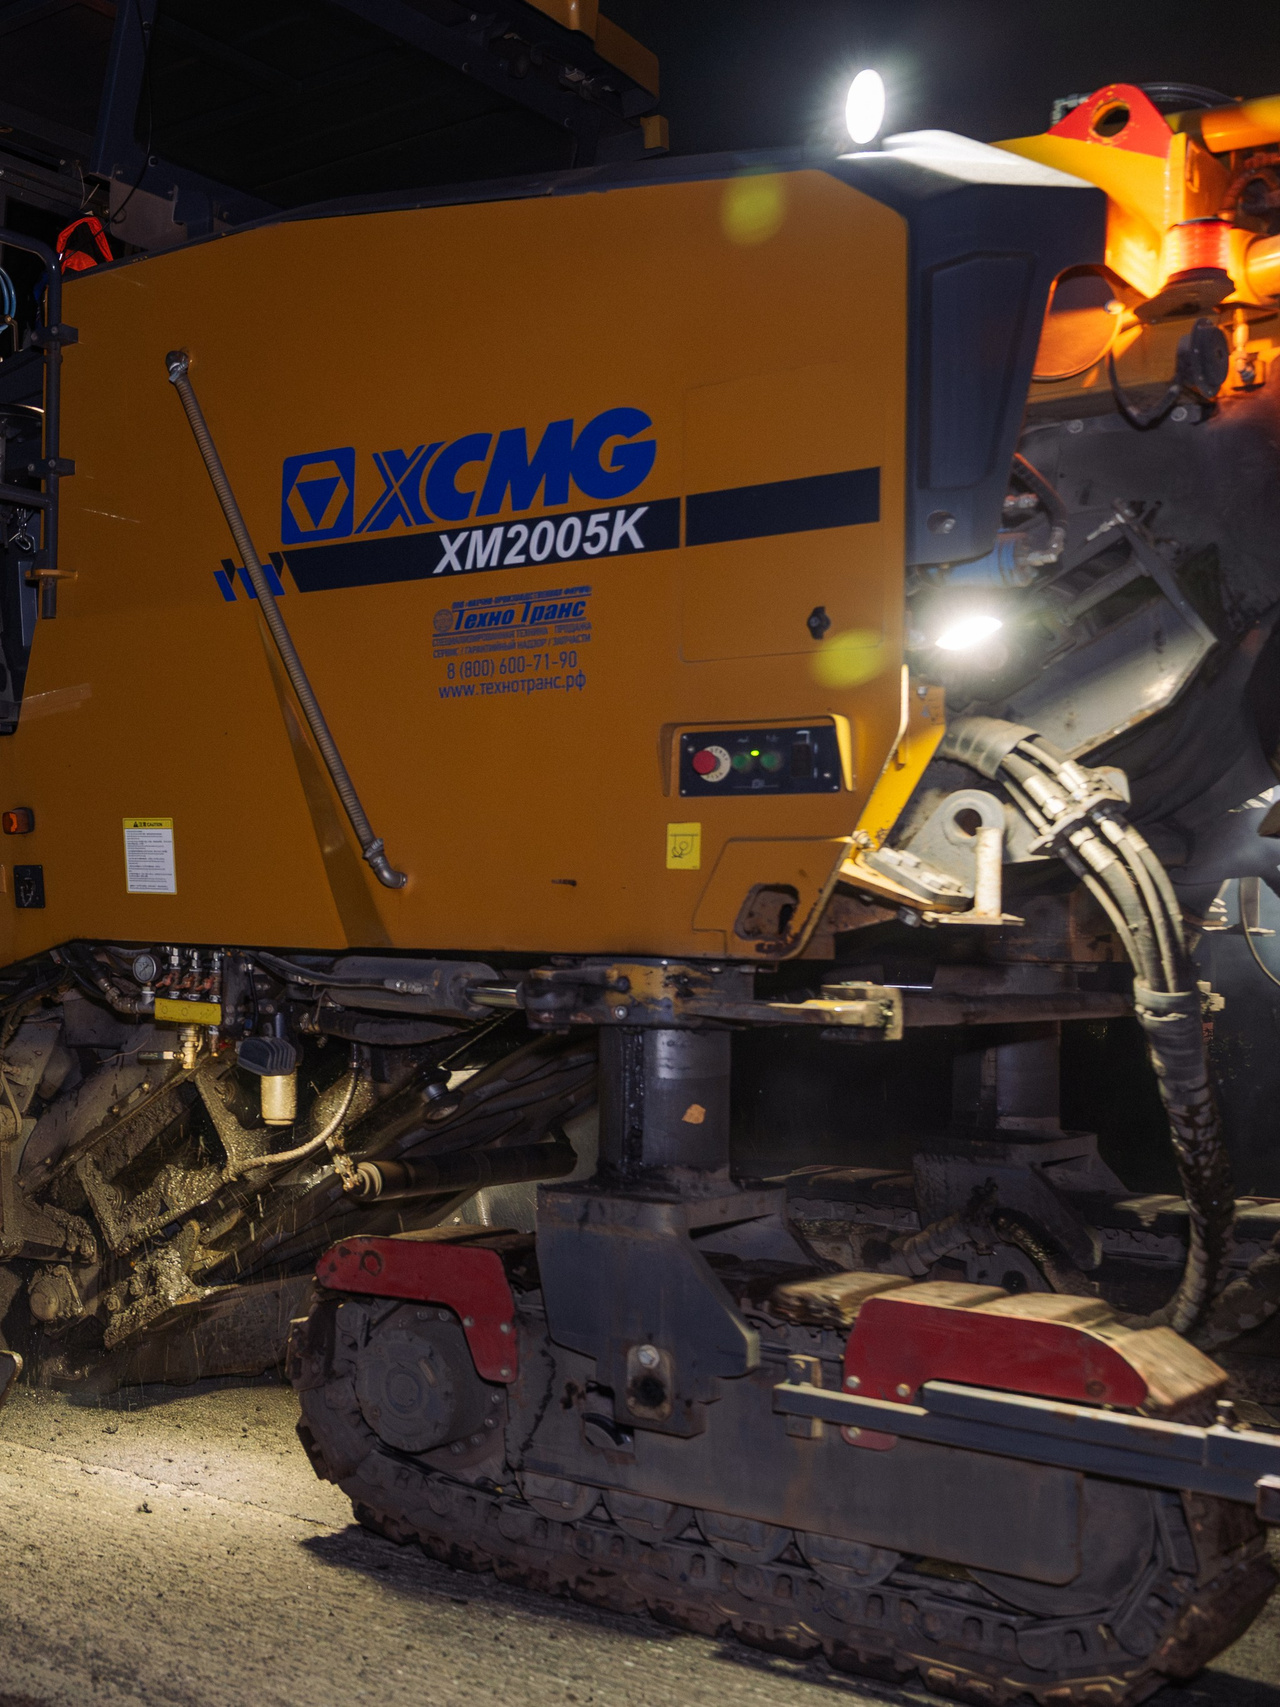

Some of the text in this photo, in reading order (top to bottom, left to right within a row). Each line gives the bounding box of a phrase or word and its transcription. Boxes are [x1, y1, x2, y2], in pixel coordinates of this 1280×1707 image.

[353, 407, 657, 534] XCMG
[432, 506, 649, 574] XM2005K
[454, 601, 586, 630] Техно Транс
[447, 651, 577, 680] 8 (800) 600-71-90
[438, 669, 586, 698] www.технотранс.рф
